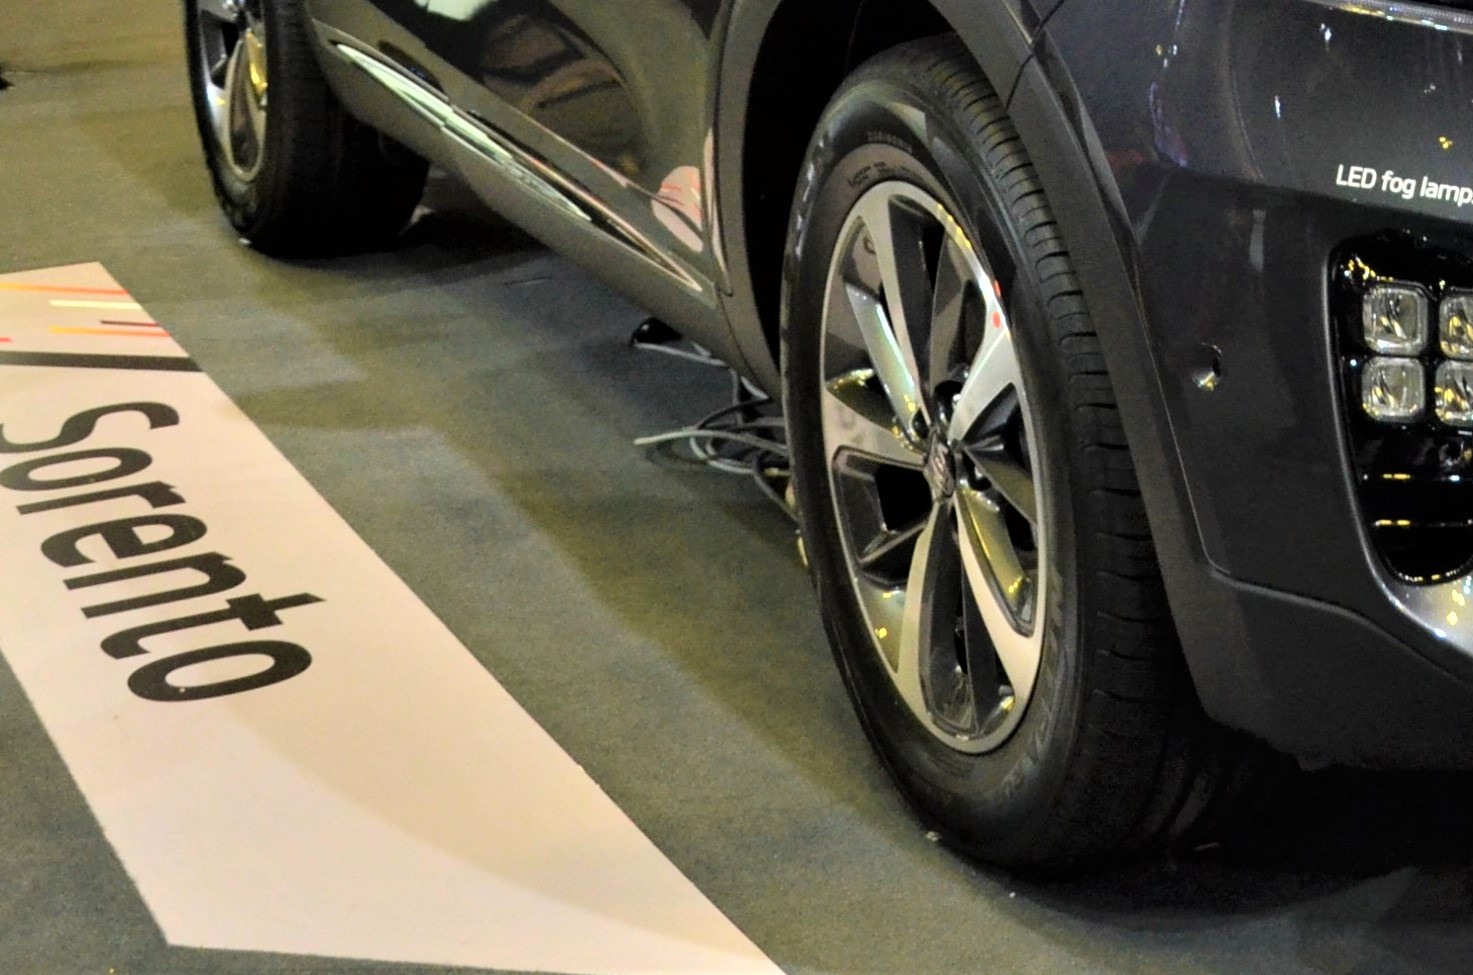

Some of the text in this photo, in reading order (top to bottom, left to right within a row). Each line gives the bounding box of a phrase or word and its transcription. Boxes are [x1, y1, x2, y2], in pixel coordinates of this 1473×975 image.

[1335, 163, 1378, 190] LED
[1381, 170, 1417, 200] fog
[0, 400, 327, 703] Sorento
